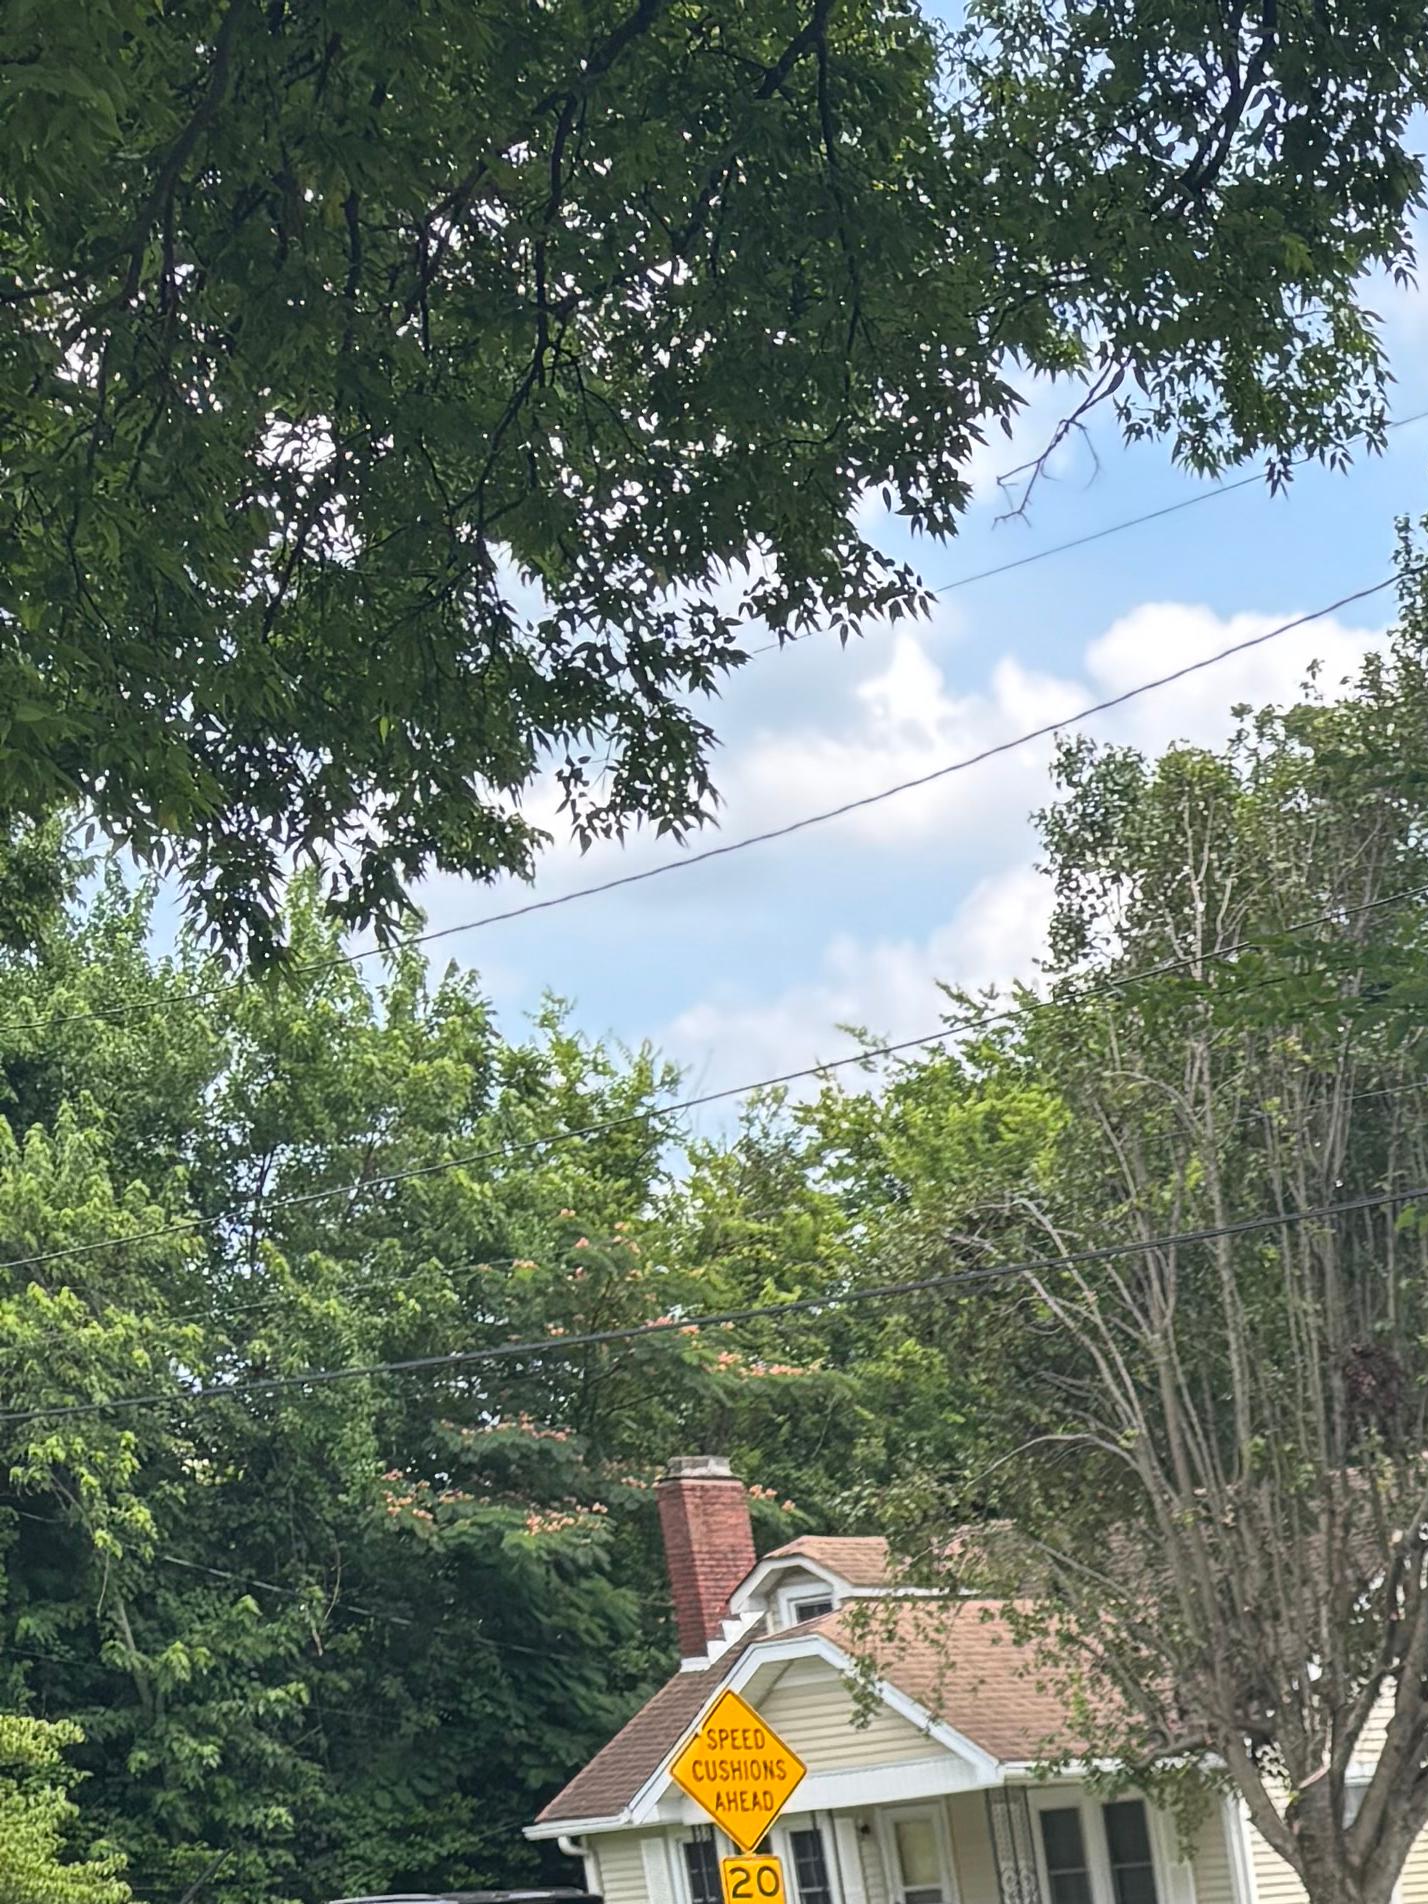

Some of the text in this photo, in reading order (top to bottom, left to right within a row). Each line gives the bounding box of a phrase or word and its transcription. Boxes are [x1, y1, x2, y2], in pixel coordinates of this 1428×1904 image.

[706, 1728, 766, 1750] SPEED
[691, 1759, 787, 1782] CUSHIONS
[714, 1790, 774, 1812] AHEAD
[728, 1866, 780, 1899] 20
